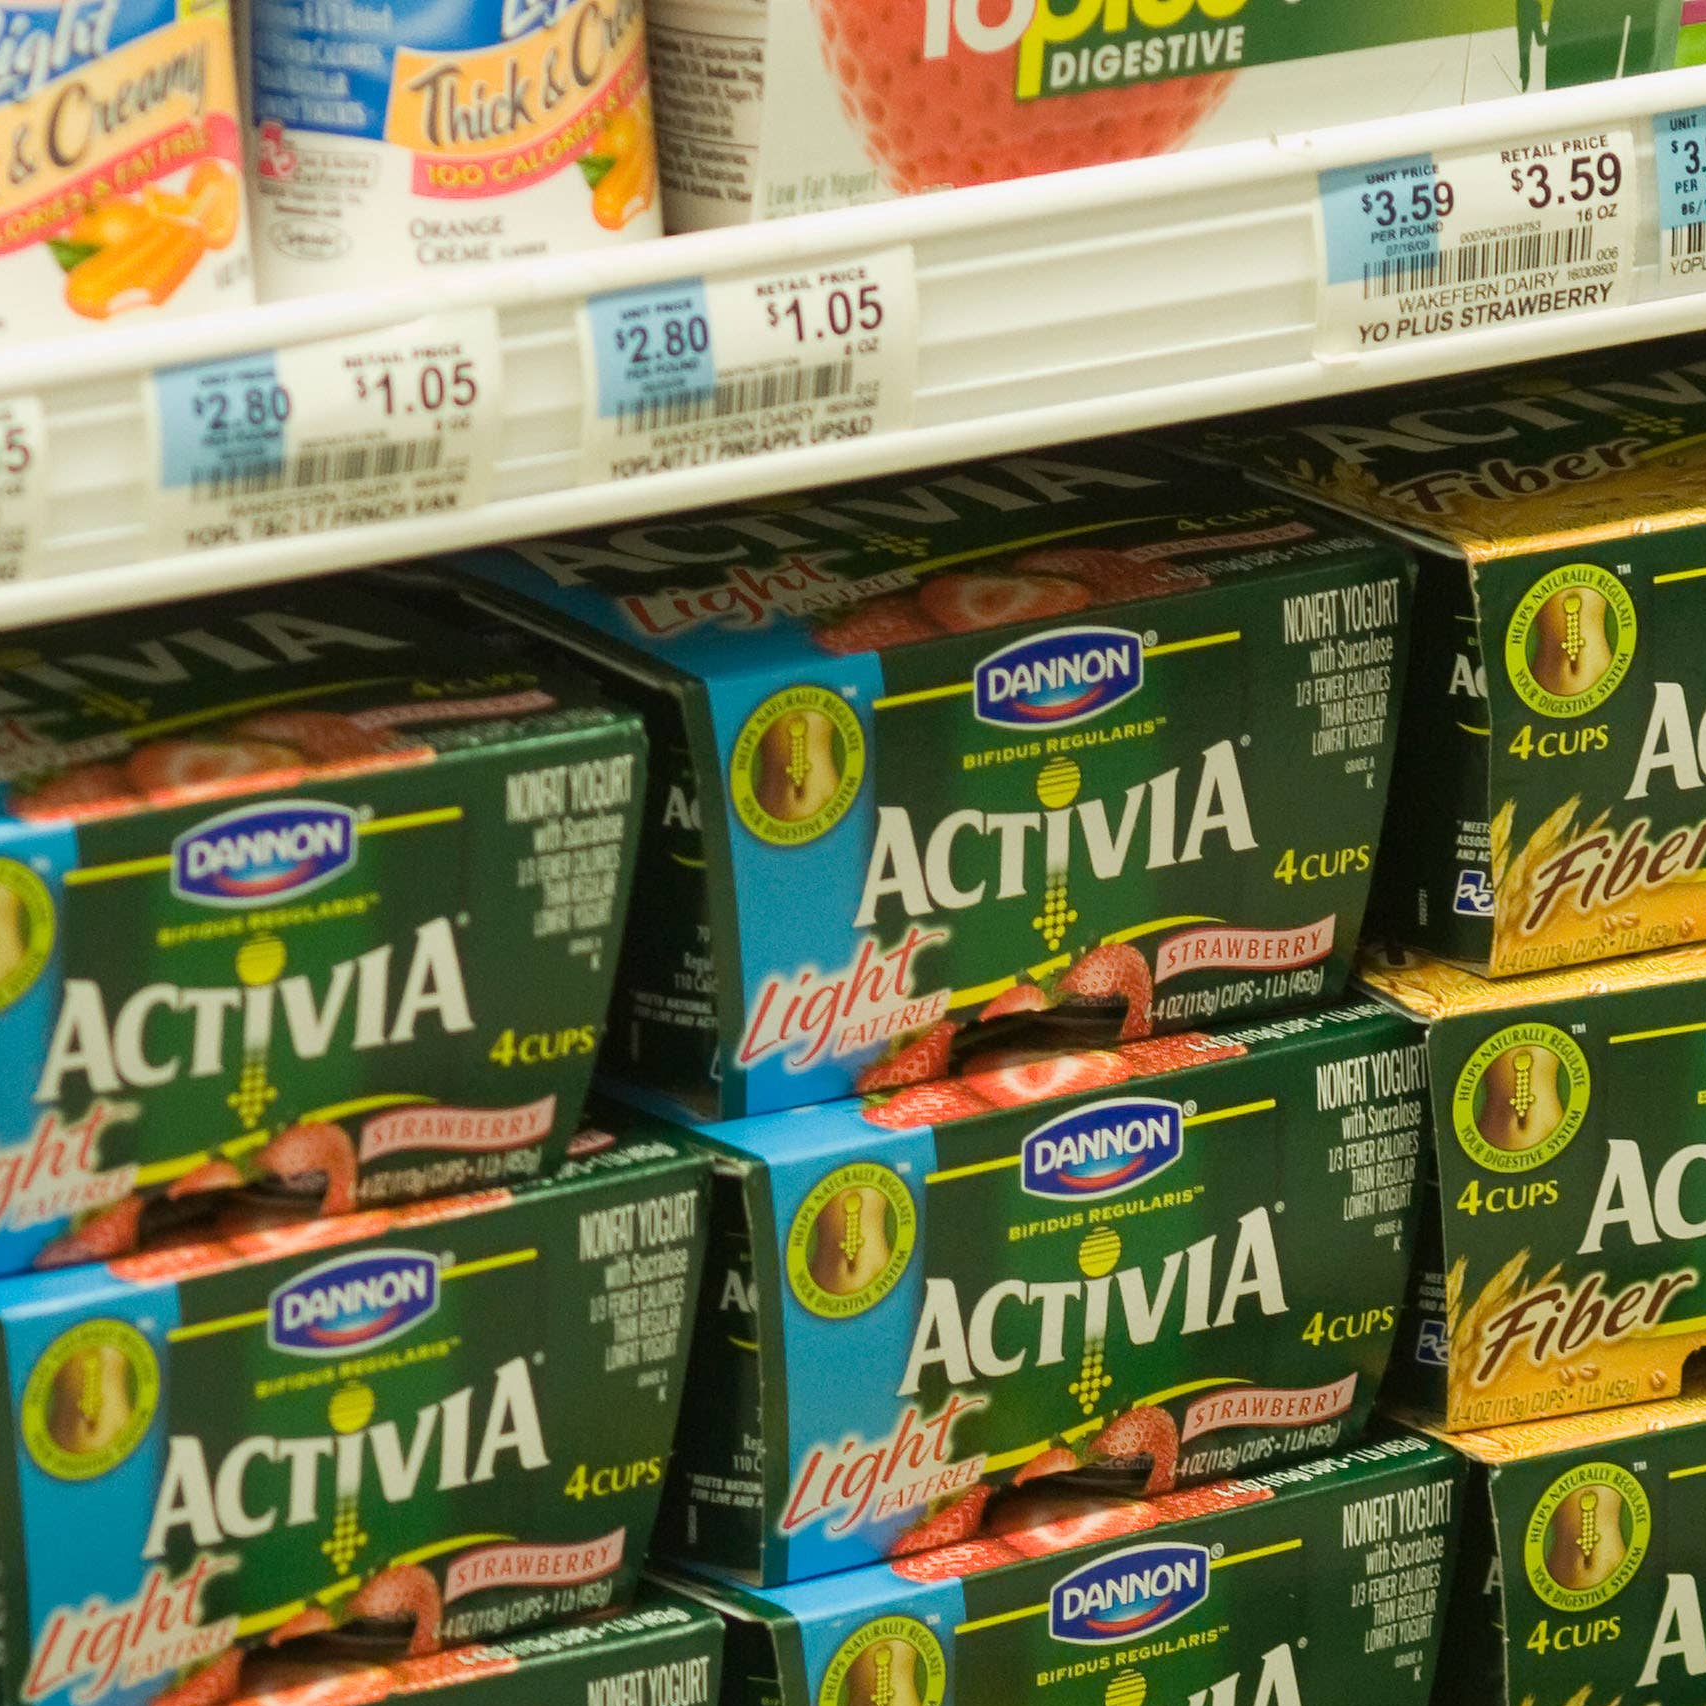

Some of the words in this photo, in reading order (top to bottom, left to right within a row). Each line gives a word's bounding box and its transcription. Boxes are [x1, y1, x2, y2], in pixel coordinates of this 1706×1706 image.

[1049, 25, 1246, 89] DIGESTIVE
[6, 127, 35, 183] &
[46, 39, 210, 169] Creamy
[1361, 181, 1454, 227] $3.59
[1511, 152, 1622, 209] $3.59
[767, 285, 883, 342] $1.05
[1359, 322, 1389, 344] YO
[1396, 311, 1453, 339] PLUS
[1460, 282, 1614, 328] STRAWBERRY
[1399, 283, 1499, 315] WAKEFERN
[1505, 271, 1558, 295] DAIRY
[615, 315, 709, 363] $2.80
[356, 362, 477, 415] $1.05
[1284, 594, 1337, 646] NONFAT
[1341, 579, 1400, 634] YOGURT
[987, 645, 1131, 701] DANNON
[1311, 649, 1336, 674] with
[1339, 636, 1394, 670] Sucralose
[962, 744, 1040, 771] BIFIDUS
[1046, 721, 1155, 755] REGULARIS
[187, 819, 343, 880] DANNON
[852, 739, 1259, 929] ACTIVIA
[1165, 931, 1324, 968] STRAWBERRY
[34, 918, 476, 1104] ACTIVIA
[738, 928, 947, 1068] Light
[1035, 1115, 1172, 1171] DANNON
[281, 1266, 429, 1330] DANNON
[897, 1206, 1289, 1397] ACTIVIA
[1477, 1269, 1698, 1385] Fiber
[1194, 1386, 1346, 1426] STRAWBERRY
[141, 1355, 550, 1559] ACTIVIA
